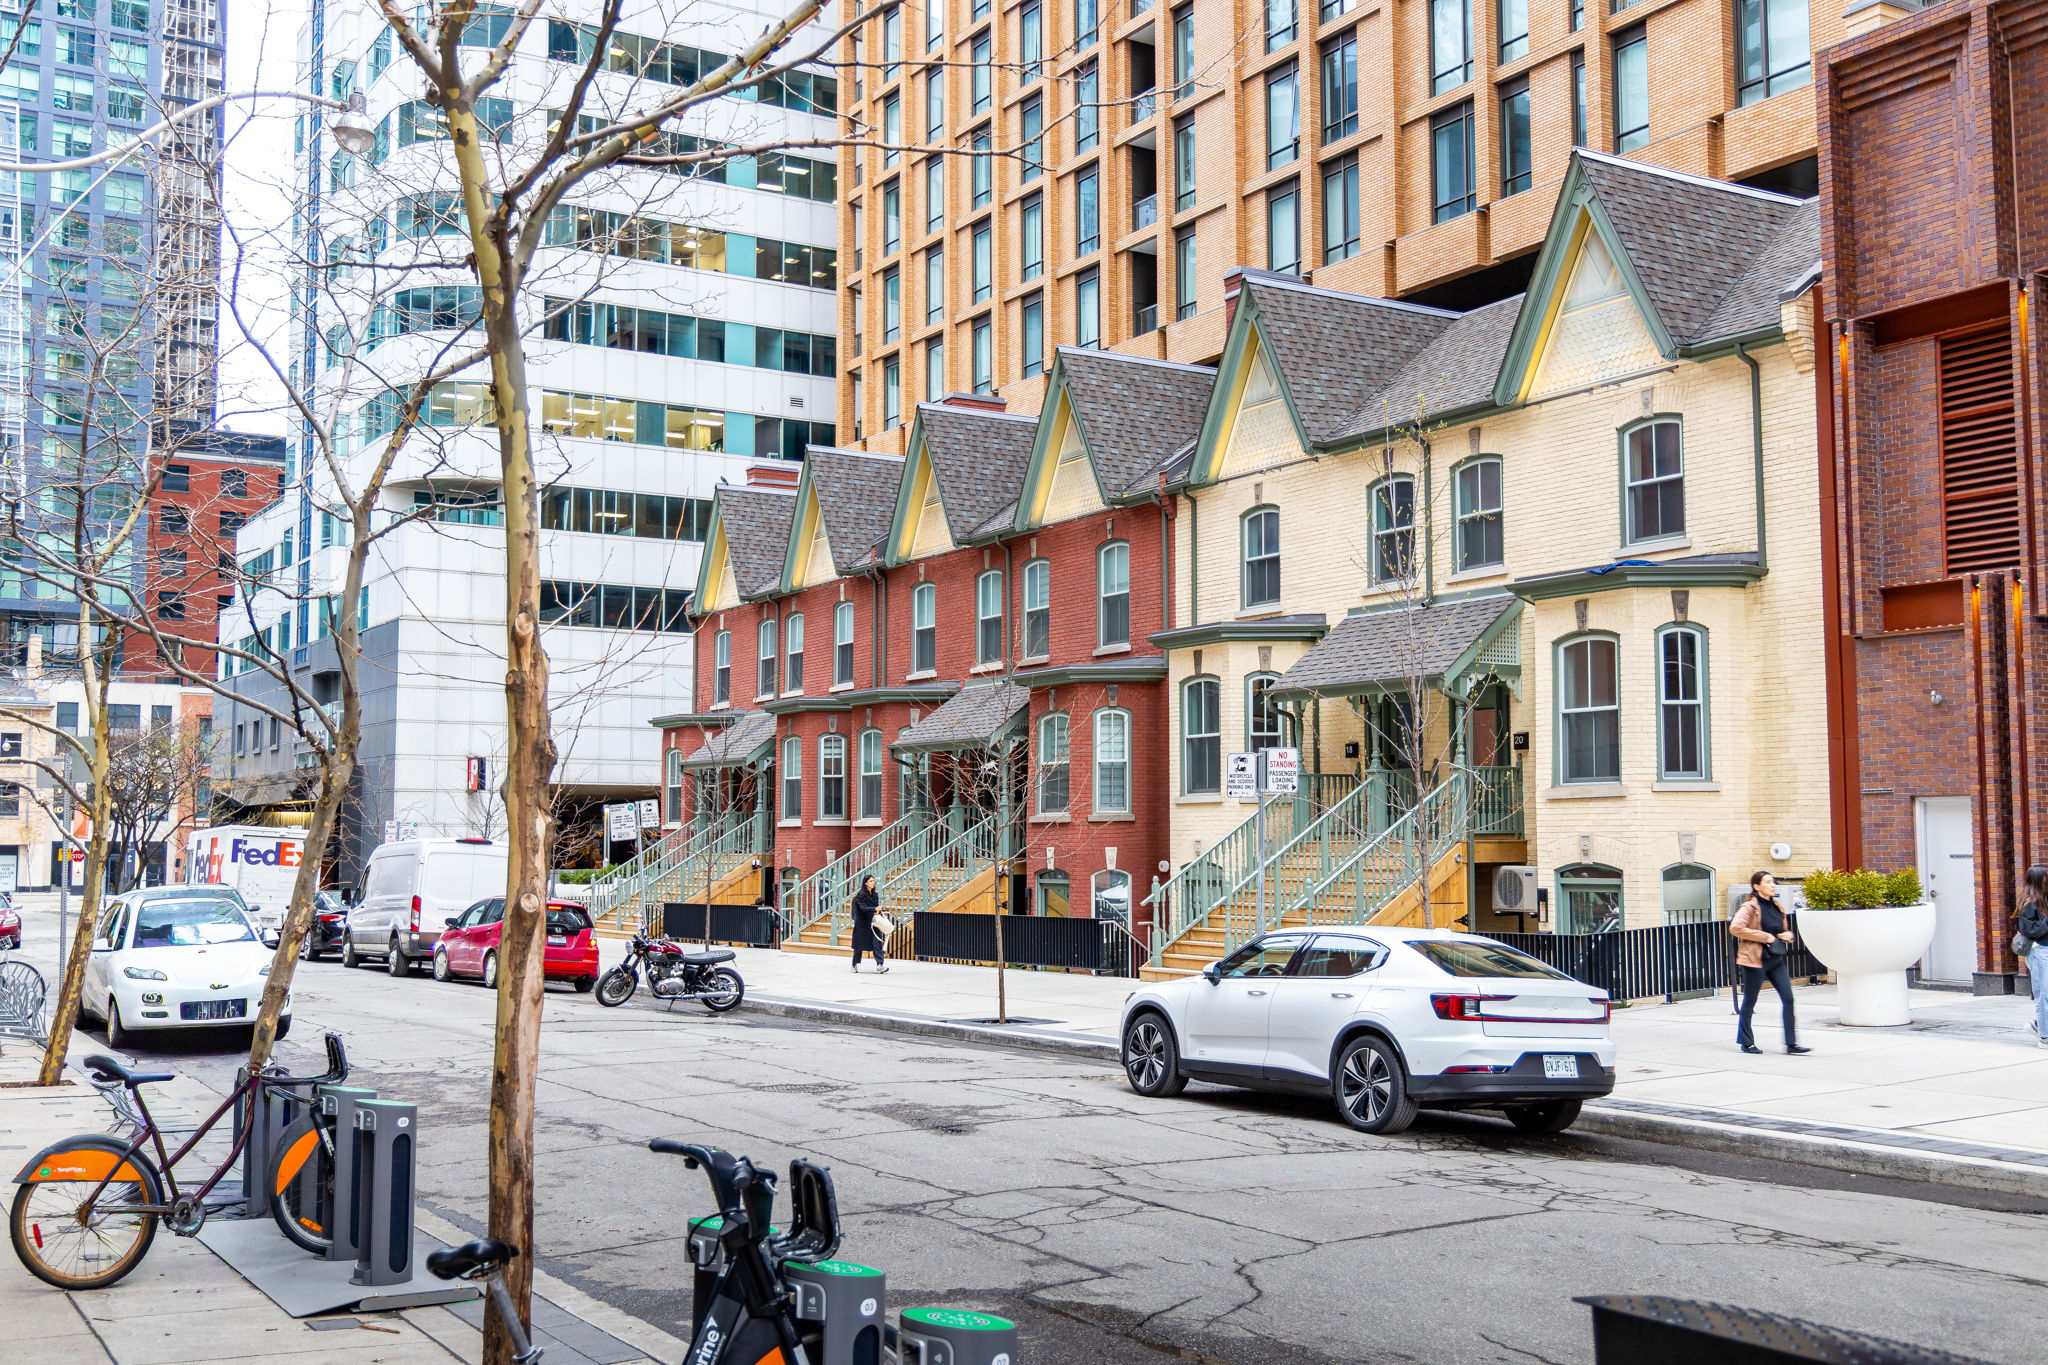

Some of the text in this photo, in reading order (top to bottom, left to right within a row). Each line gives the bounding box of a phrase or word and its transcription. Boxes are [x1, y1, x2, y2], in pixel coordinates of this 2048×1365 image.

[1514, 735, 1524, 744] 20
[1278, 751, 1288, 760] NO
[194, 837, 224, 883] FedEx
[864, 1303, 874, 1311] 03
[695, 1330, 720, 1365] rine
